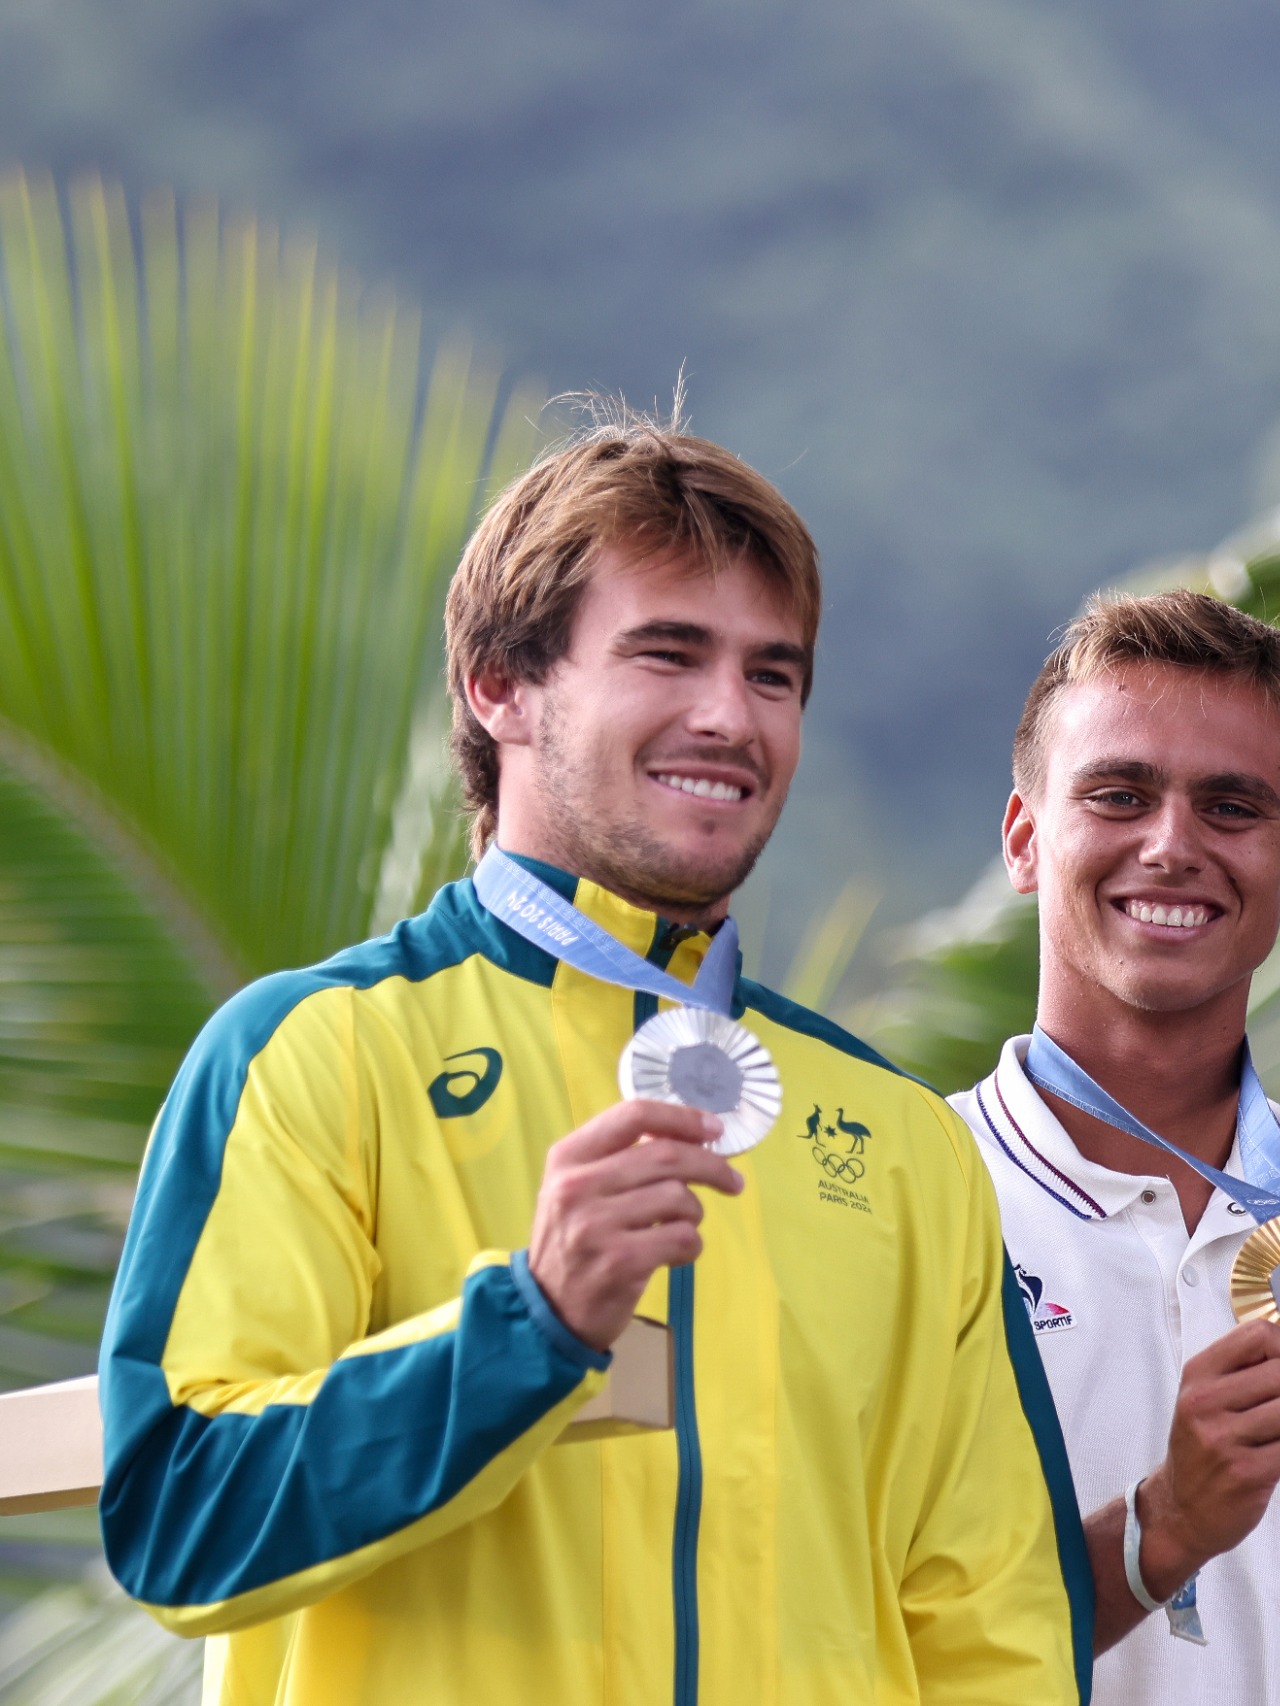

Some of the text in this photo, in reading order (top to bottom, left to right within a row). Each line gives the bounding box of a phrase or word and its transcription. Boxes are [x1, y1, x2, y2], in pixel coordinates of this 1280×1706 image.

[507, 892, 545, 923] 2024
[818, 1180, 869, 1203] AUSTRALIA
[820, 1192, 872, 1214] PARIS 2024
[1033, 1315, 1073, 1331] SPORTIF
